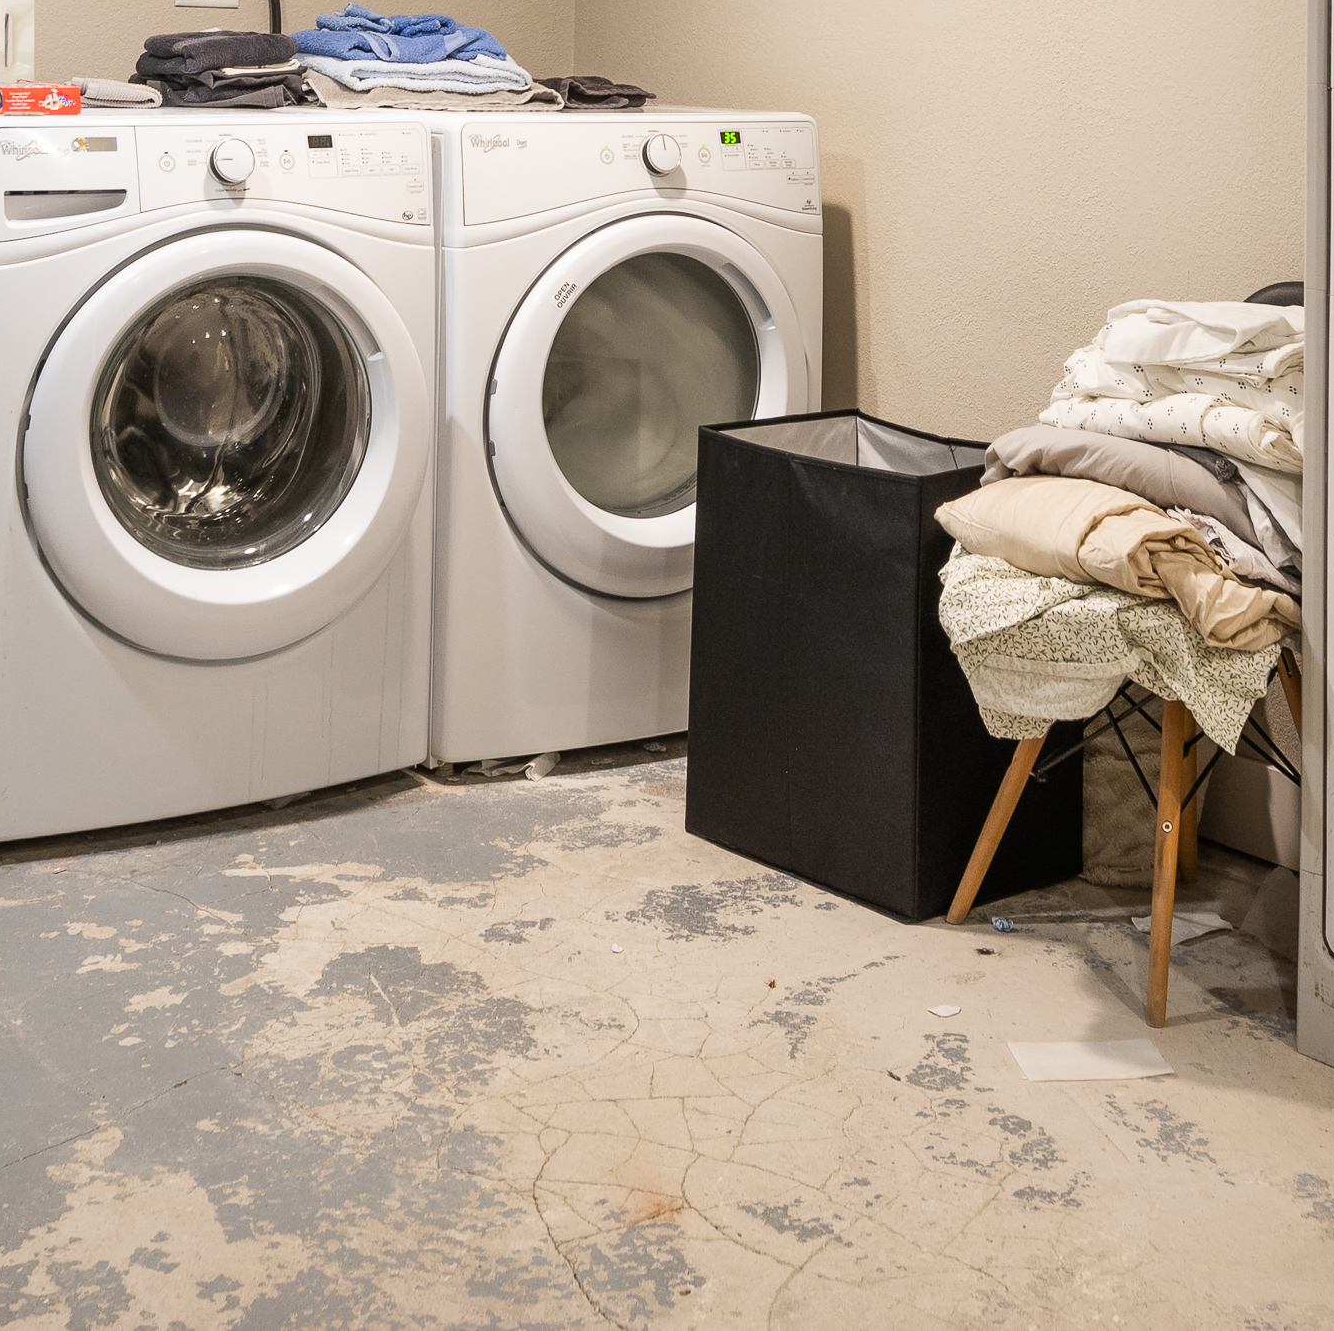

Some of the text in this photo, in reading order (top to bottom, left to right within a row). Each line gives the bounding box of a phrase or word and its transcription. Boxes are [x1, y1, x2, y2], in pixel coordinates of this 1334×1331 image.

[468, 134, 510, 153] Whirlpool
[724, 132, 737, 144] 35
[554, 281, 570, 300] OPEN
[556, 283, 577, 308] OUVRIR
